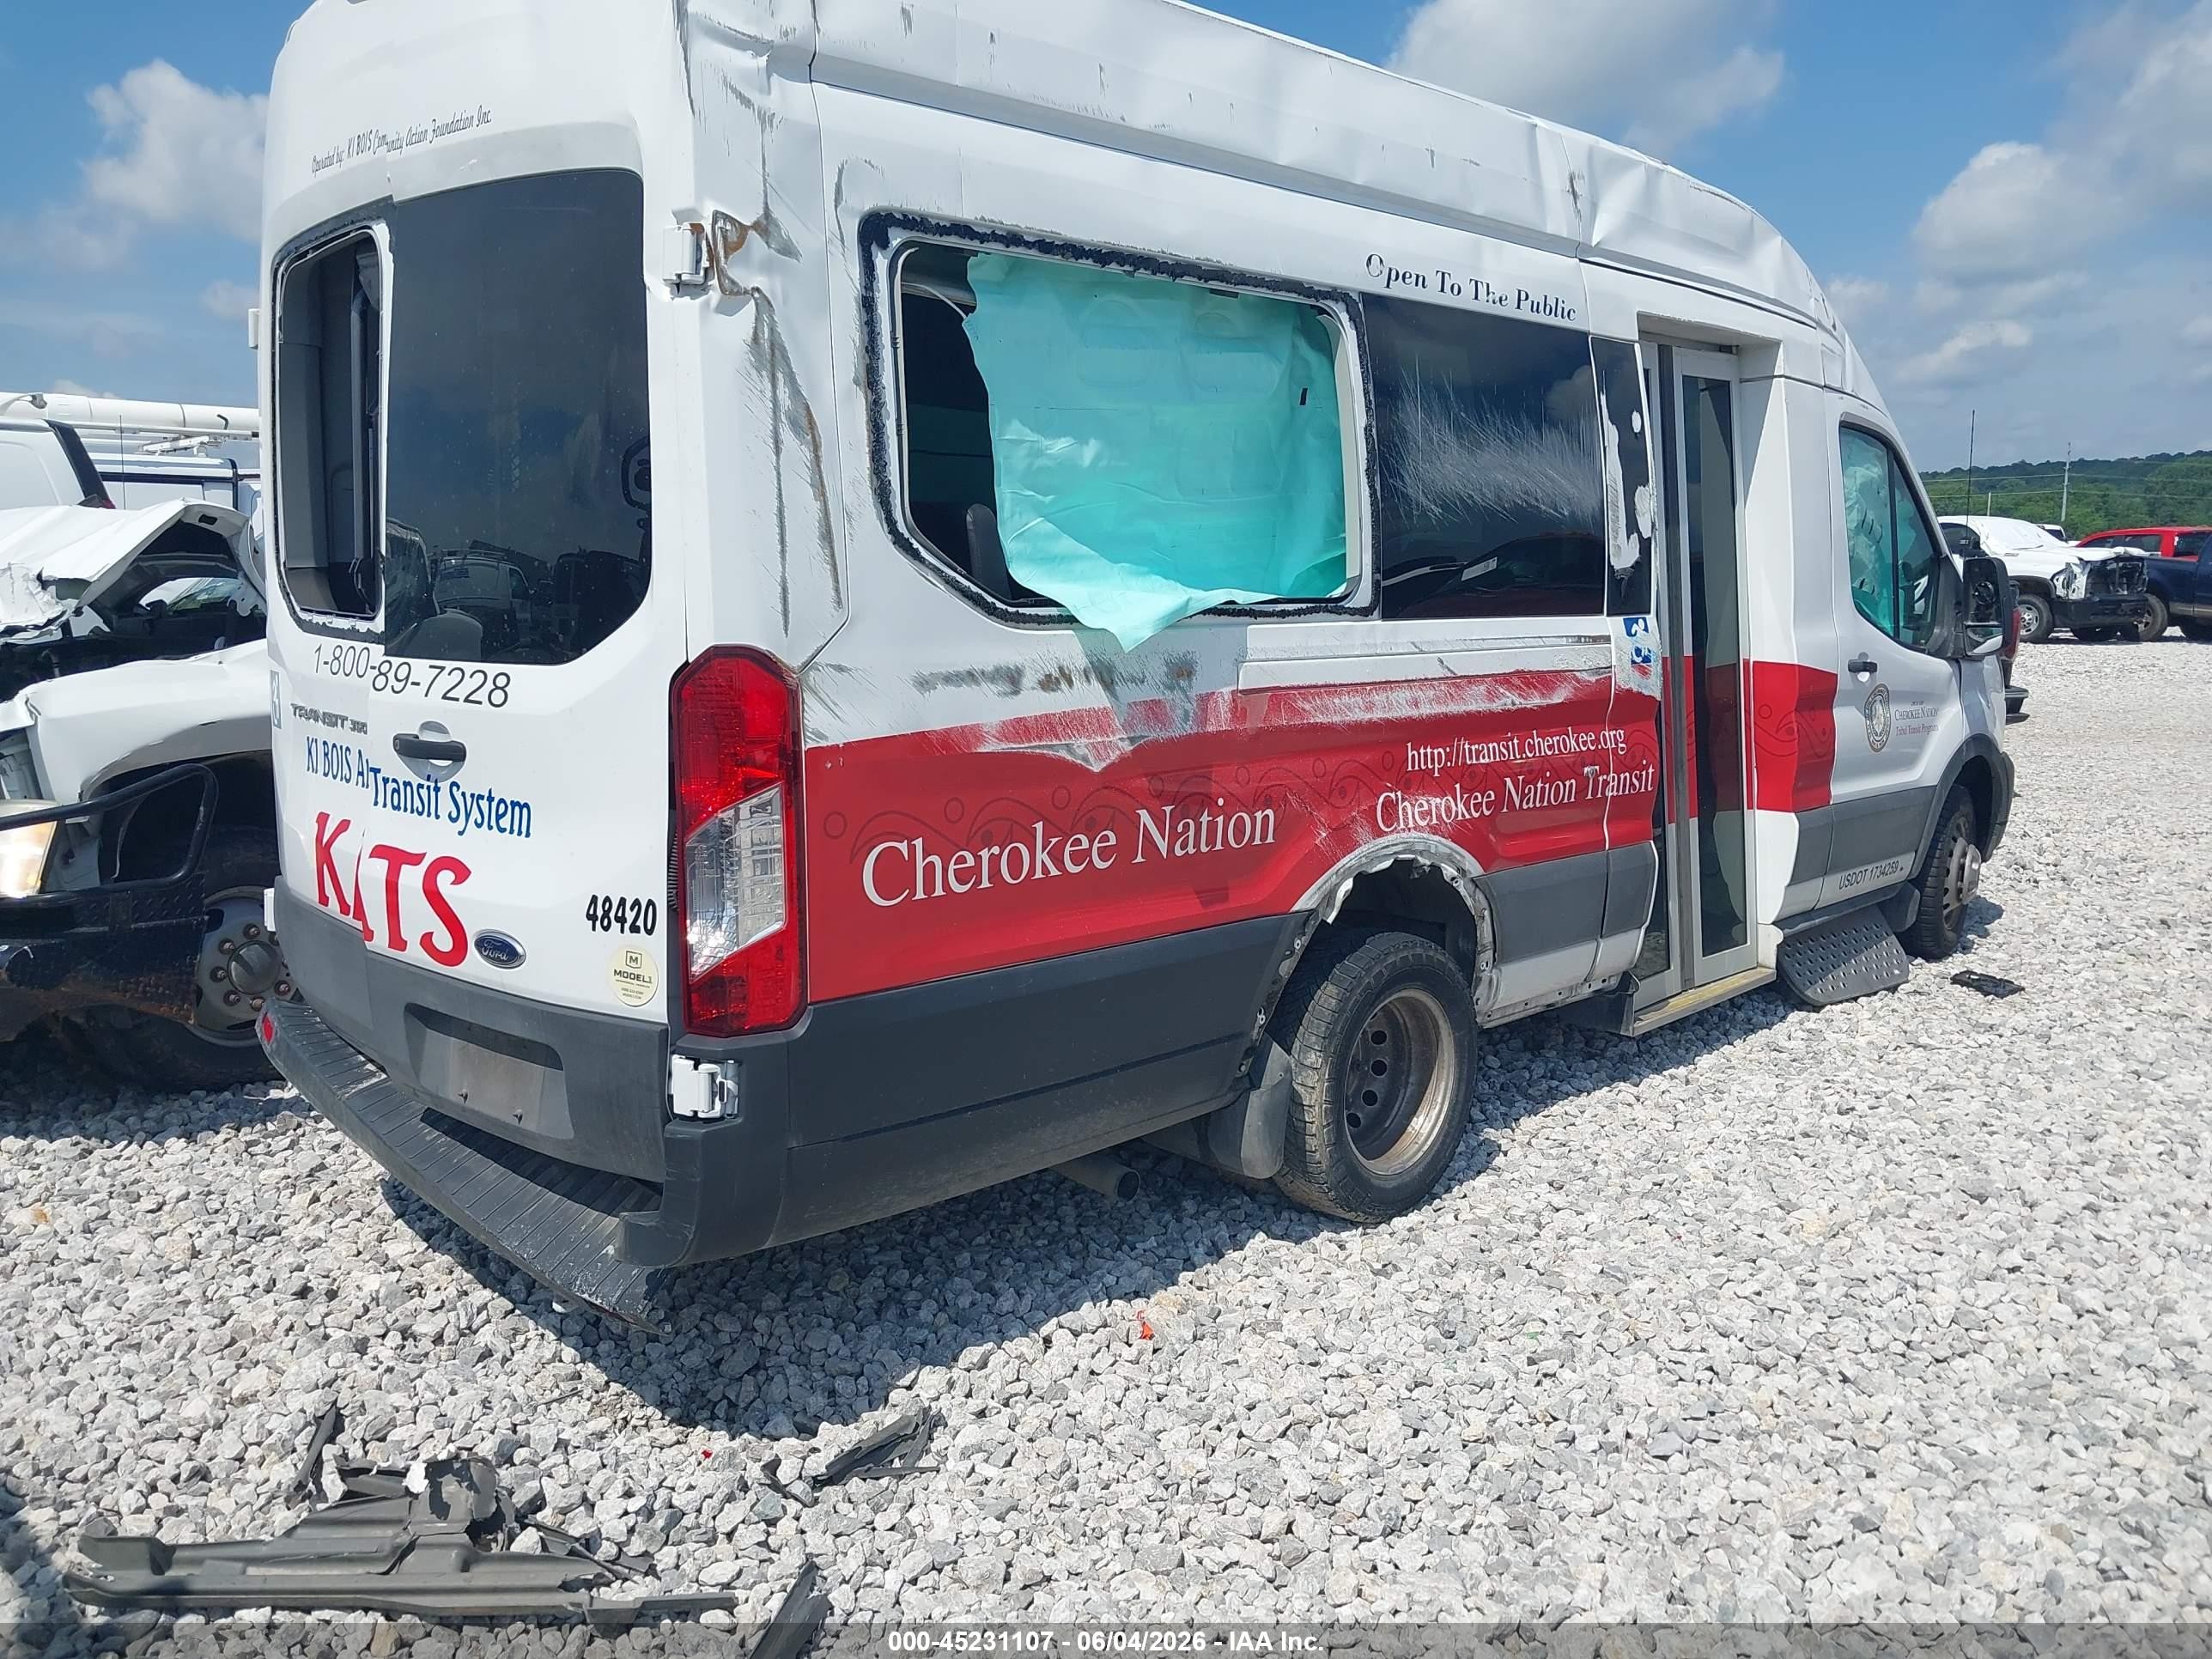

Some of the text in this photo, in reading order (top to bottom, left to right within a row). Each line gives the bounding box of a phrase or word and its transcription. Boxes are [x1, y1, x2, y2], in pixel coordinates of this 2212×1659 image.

[347, 136, 356, 158] KI
[356, 129, 372, 156] BOIS
[405, 124, 428, 147] Action
[429, 110, 474, 143] Foundation
[476, 104, 492, 127] Inc.
[1365, 253, 1577, 321] Open To The Public
[290, 702, 349, 731] TRANSIT
[1406, 726, 1627, 777] http://transit.cherokee.org
[307, 736, 318, 775] KI
[322, 740, 352, 783] BOIS
[369, 767, 441, 819] Transit
[447, 781, 532, 838] System
[1376, 759, 1655, 832] Cherokee Nation Transit
[862, 797, 1275, 907] Cherokee Nation
[1838, 868, 1869, 890] USDOT
[585, 894, 658, 936] 48420
[482, 939, 509, 961] Ford
[629, 955, 639, 965] M
